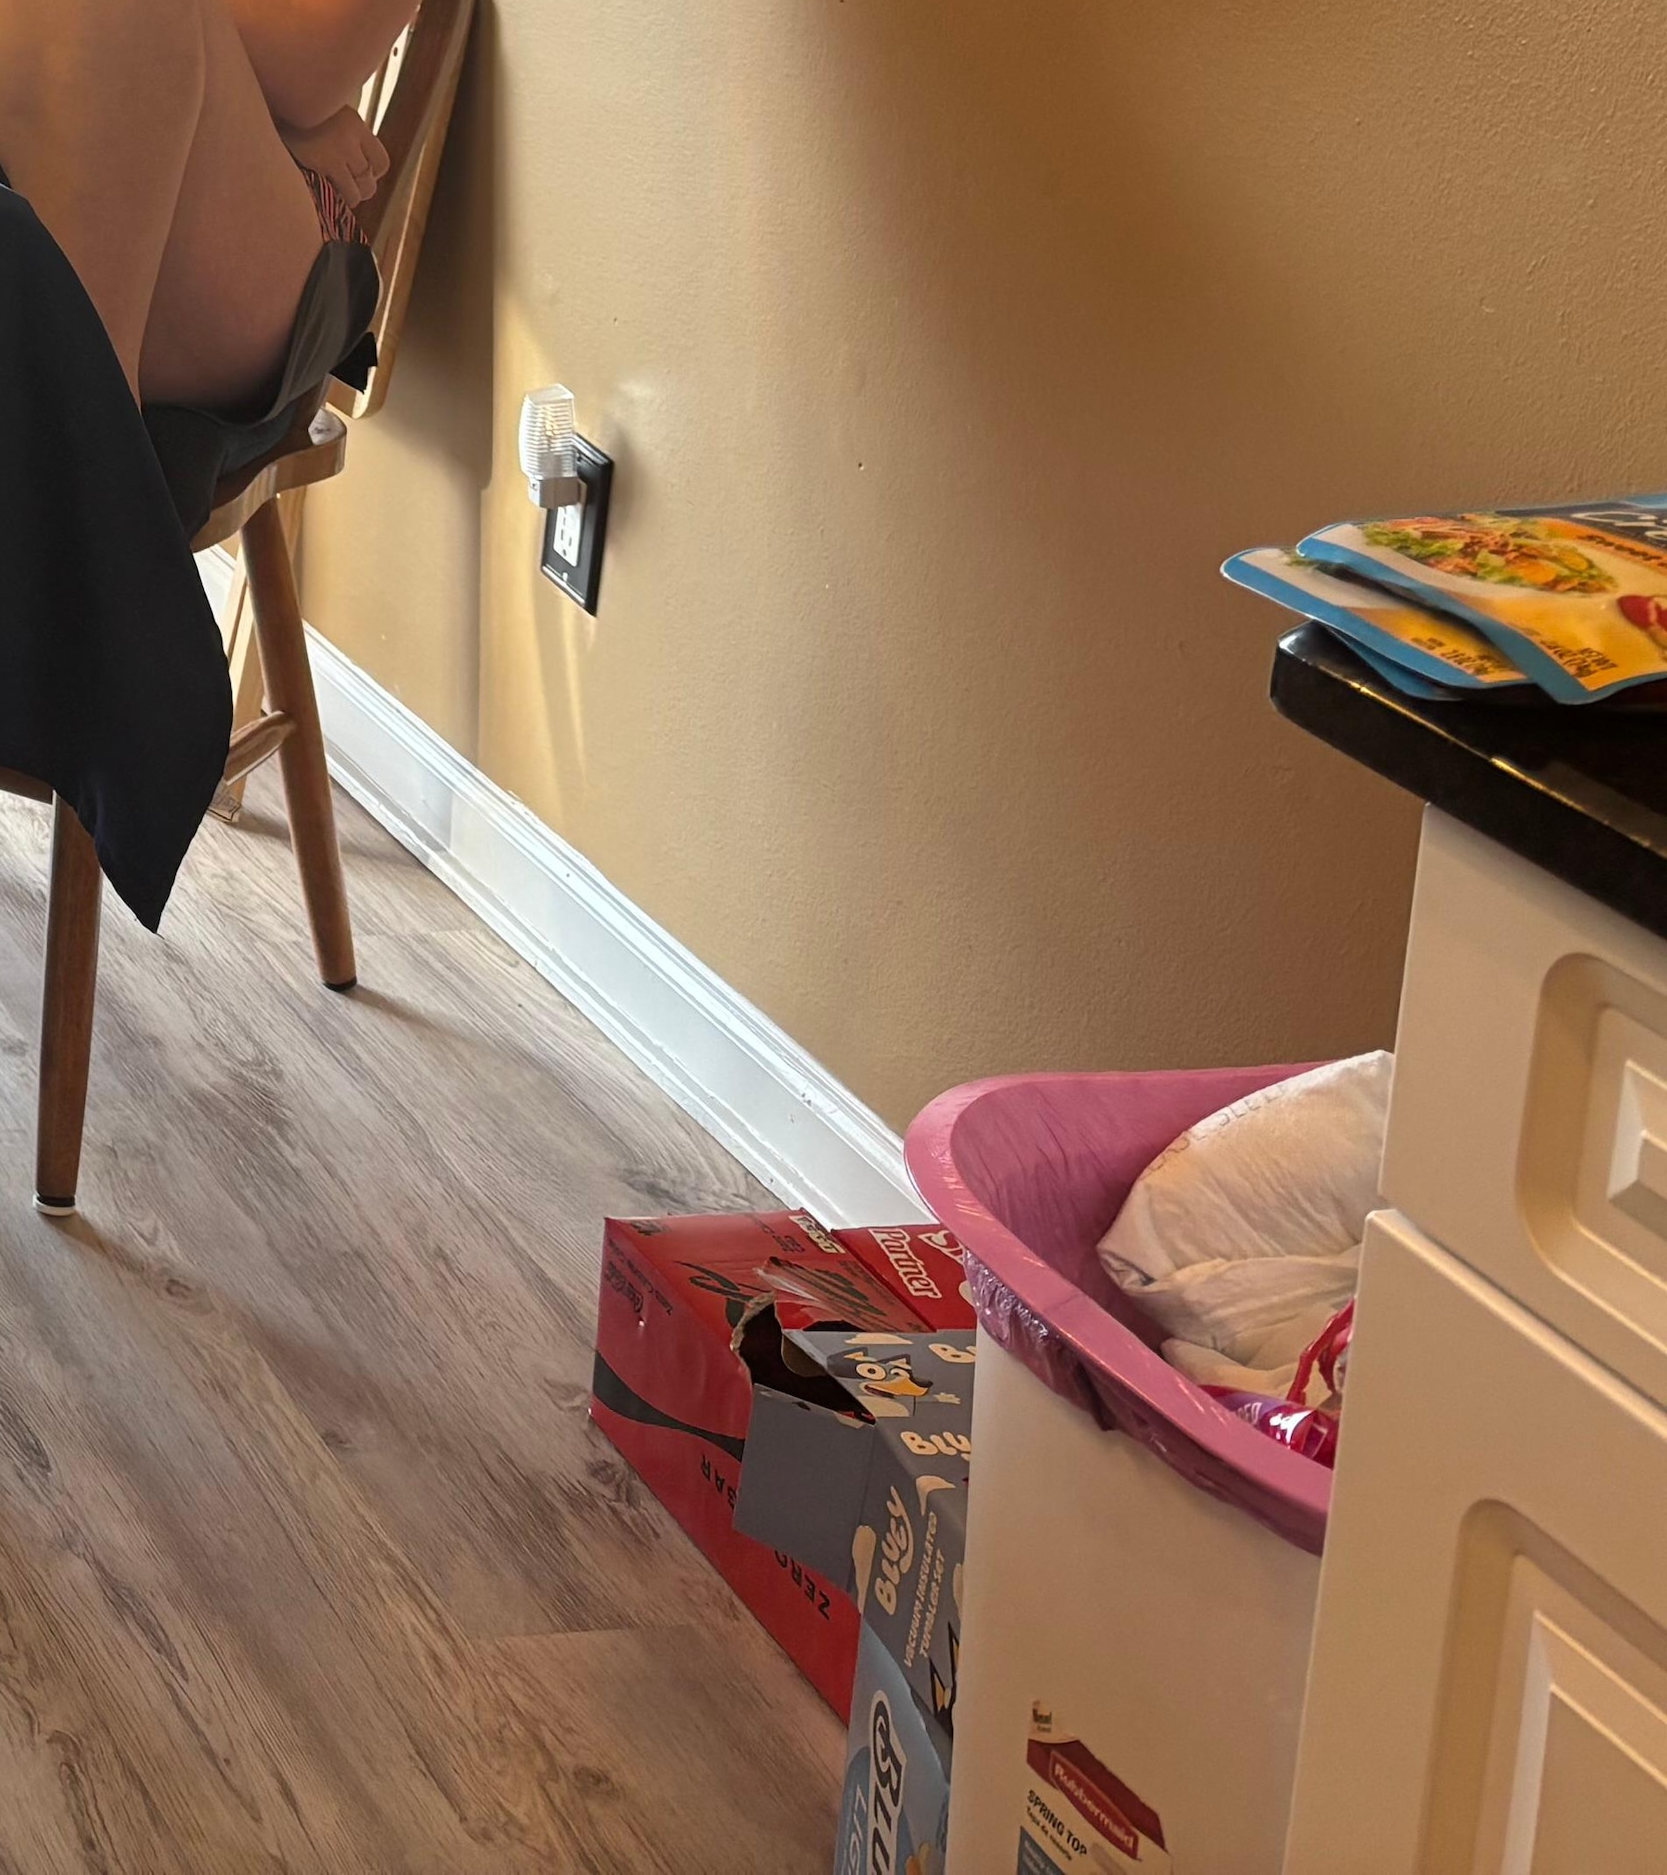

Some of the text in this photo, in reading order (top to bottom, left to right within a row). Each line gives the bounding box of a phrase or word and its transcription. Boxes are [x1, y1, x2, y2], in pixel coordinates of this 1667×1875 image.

[869, 1227, 943, 1300] Partner
[1027, 1789, 1066, 1836] SPRING
[1066, 1829, 1088, 1857] TOP
[1053, 1761, 1135, 1851] Rubbermaid
